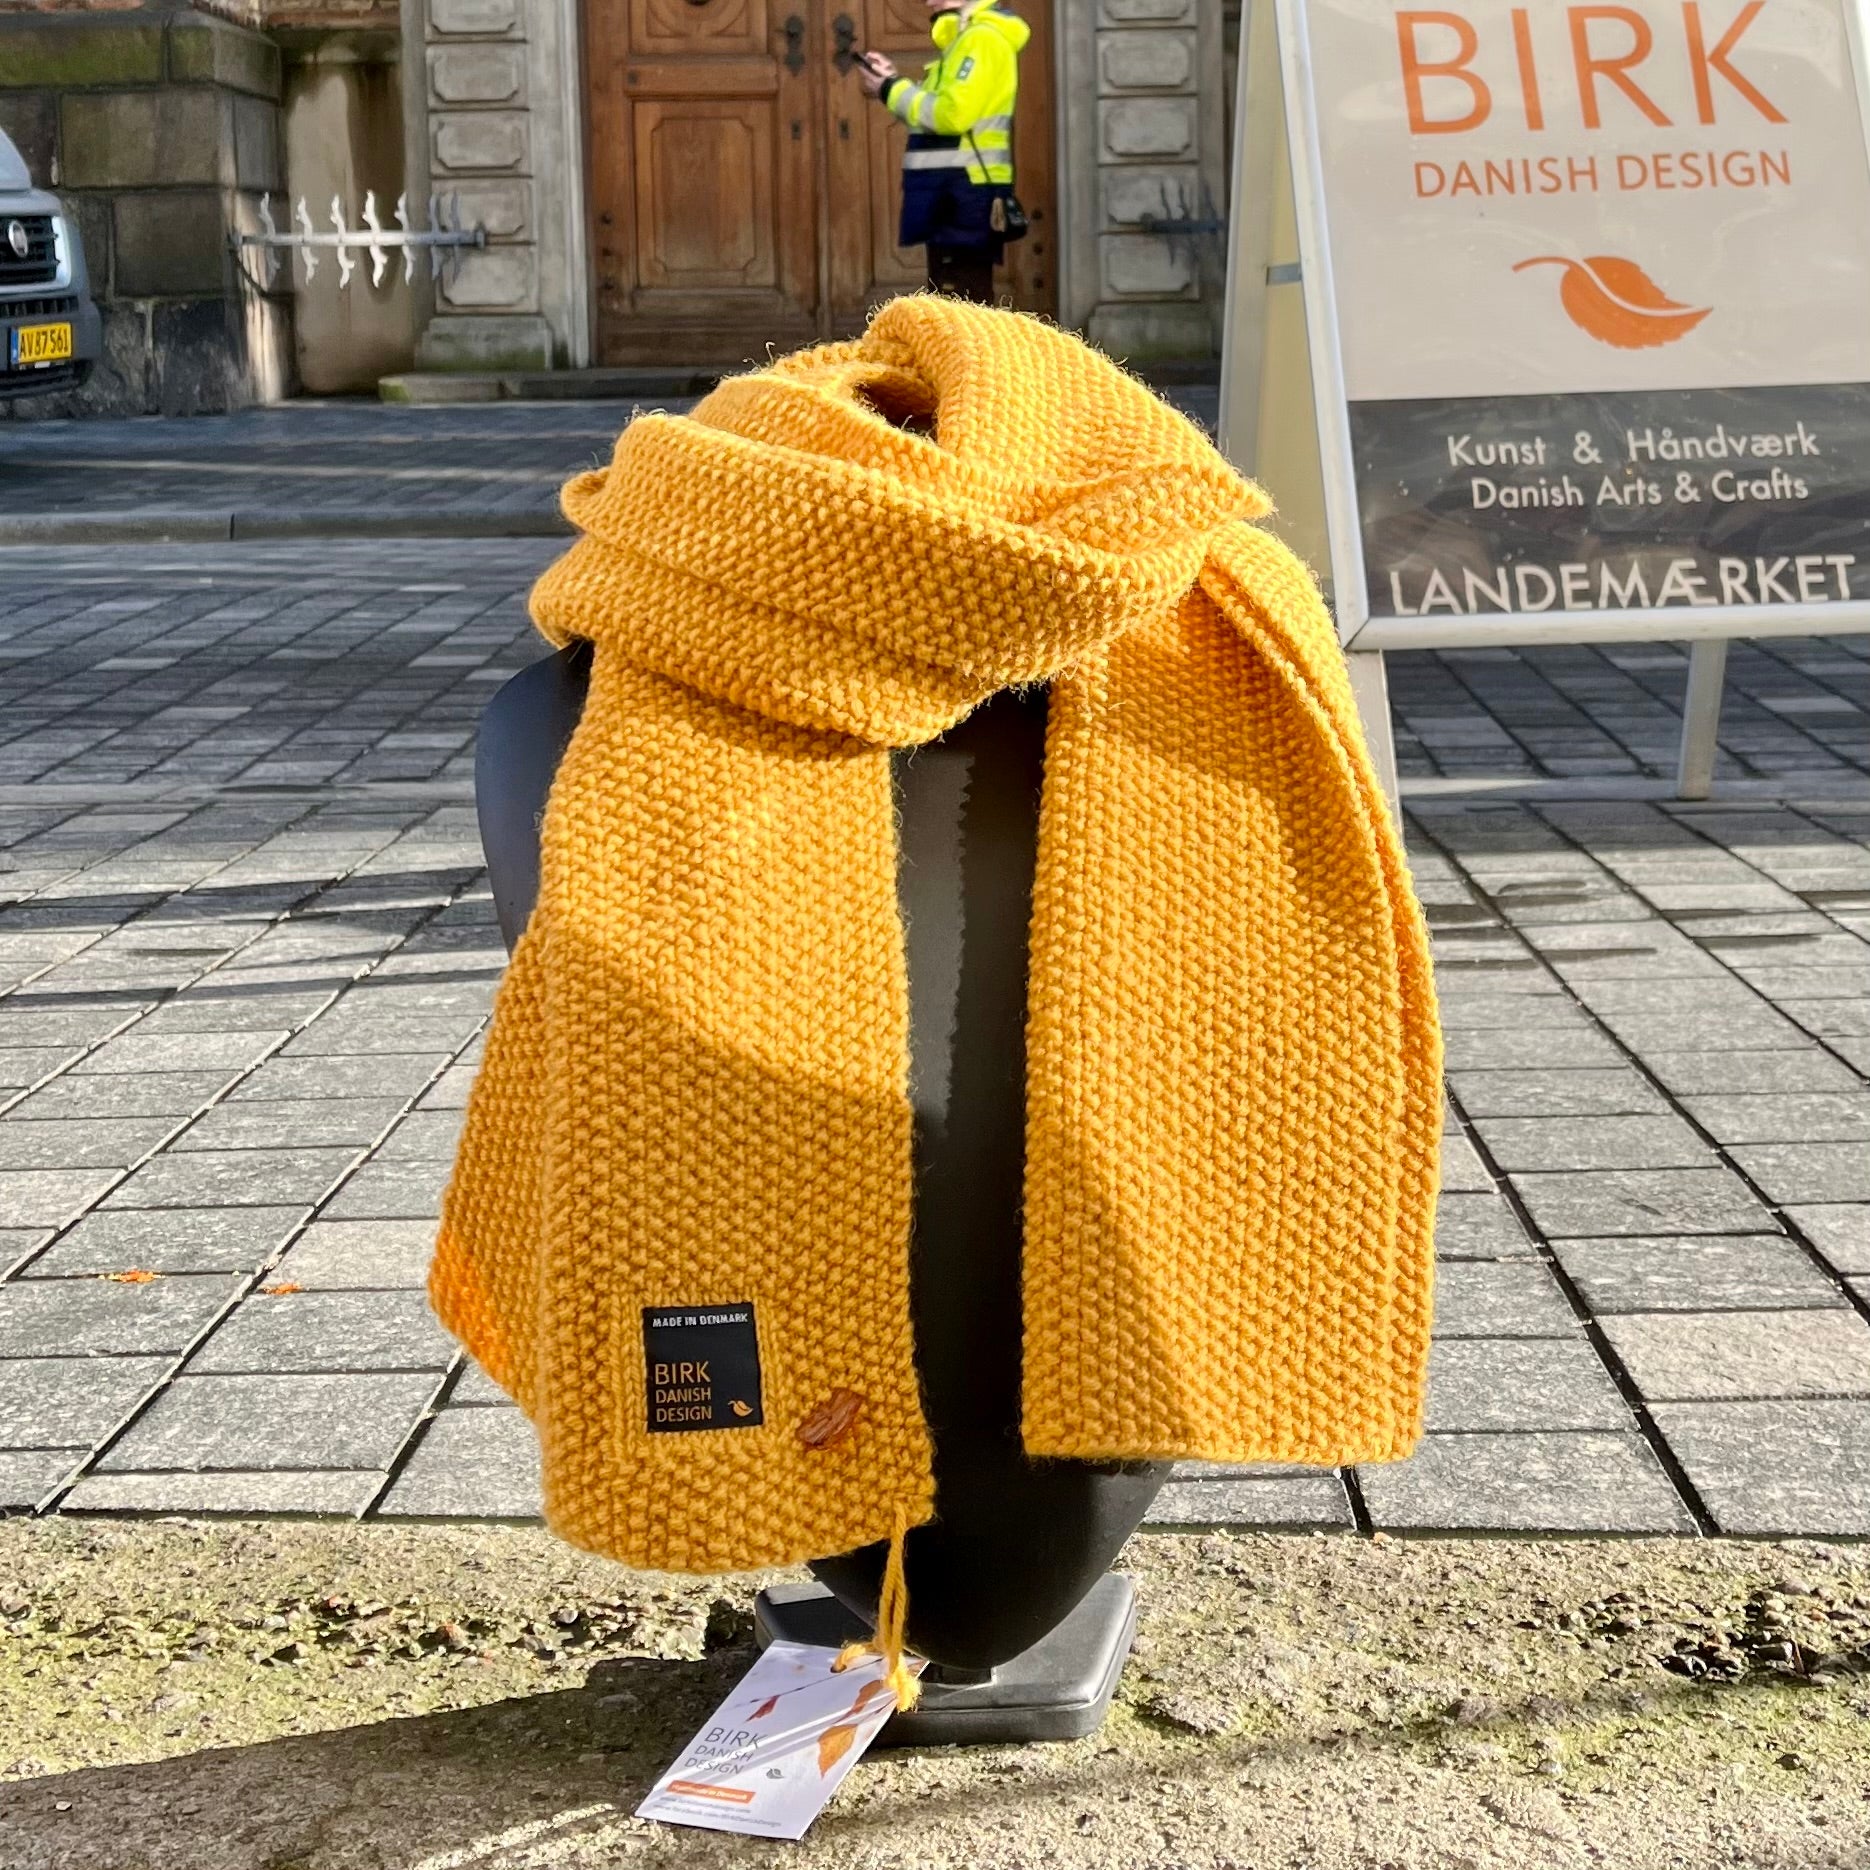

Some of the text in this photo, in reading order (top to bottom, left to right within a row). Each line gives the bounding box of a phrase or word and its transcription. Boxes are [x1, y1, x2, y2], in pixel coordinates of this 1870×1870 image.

[1395, 1, 1789, 134] BIRK
[1414, 151, 1791, 198] DANISH DESIGN
[1448, 422, 1820, 467] Kunst & Håndværk
[1471, 467, 1809, 510] Danish Arts & Crafts
[1390, 555, 1855, 616] LANDEMÆRKET
[653, 1313, 748, 1328] MADE IN DENMARK
[655, 1361, 711, 1385] BIRK
[656, 1387, 711, 1404] DANISH
[656, 1405, 712, 1423] DESIGN
[705, 1727, 768, 1749] BIRK
